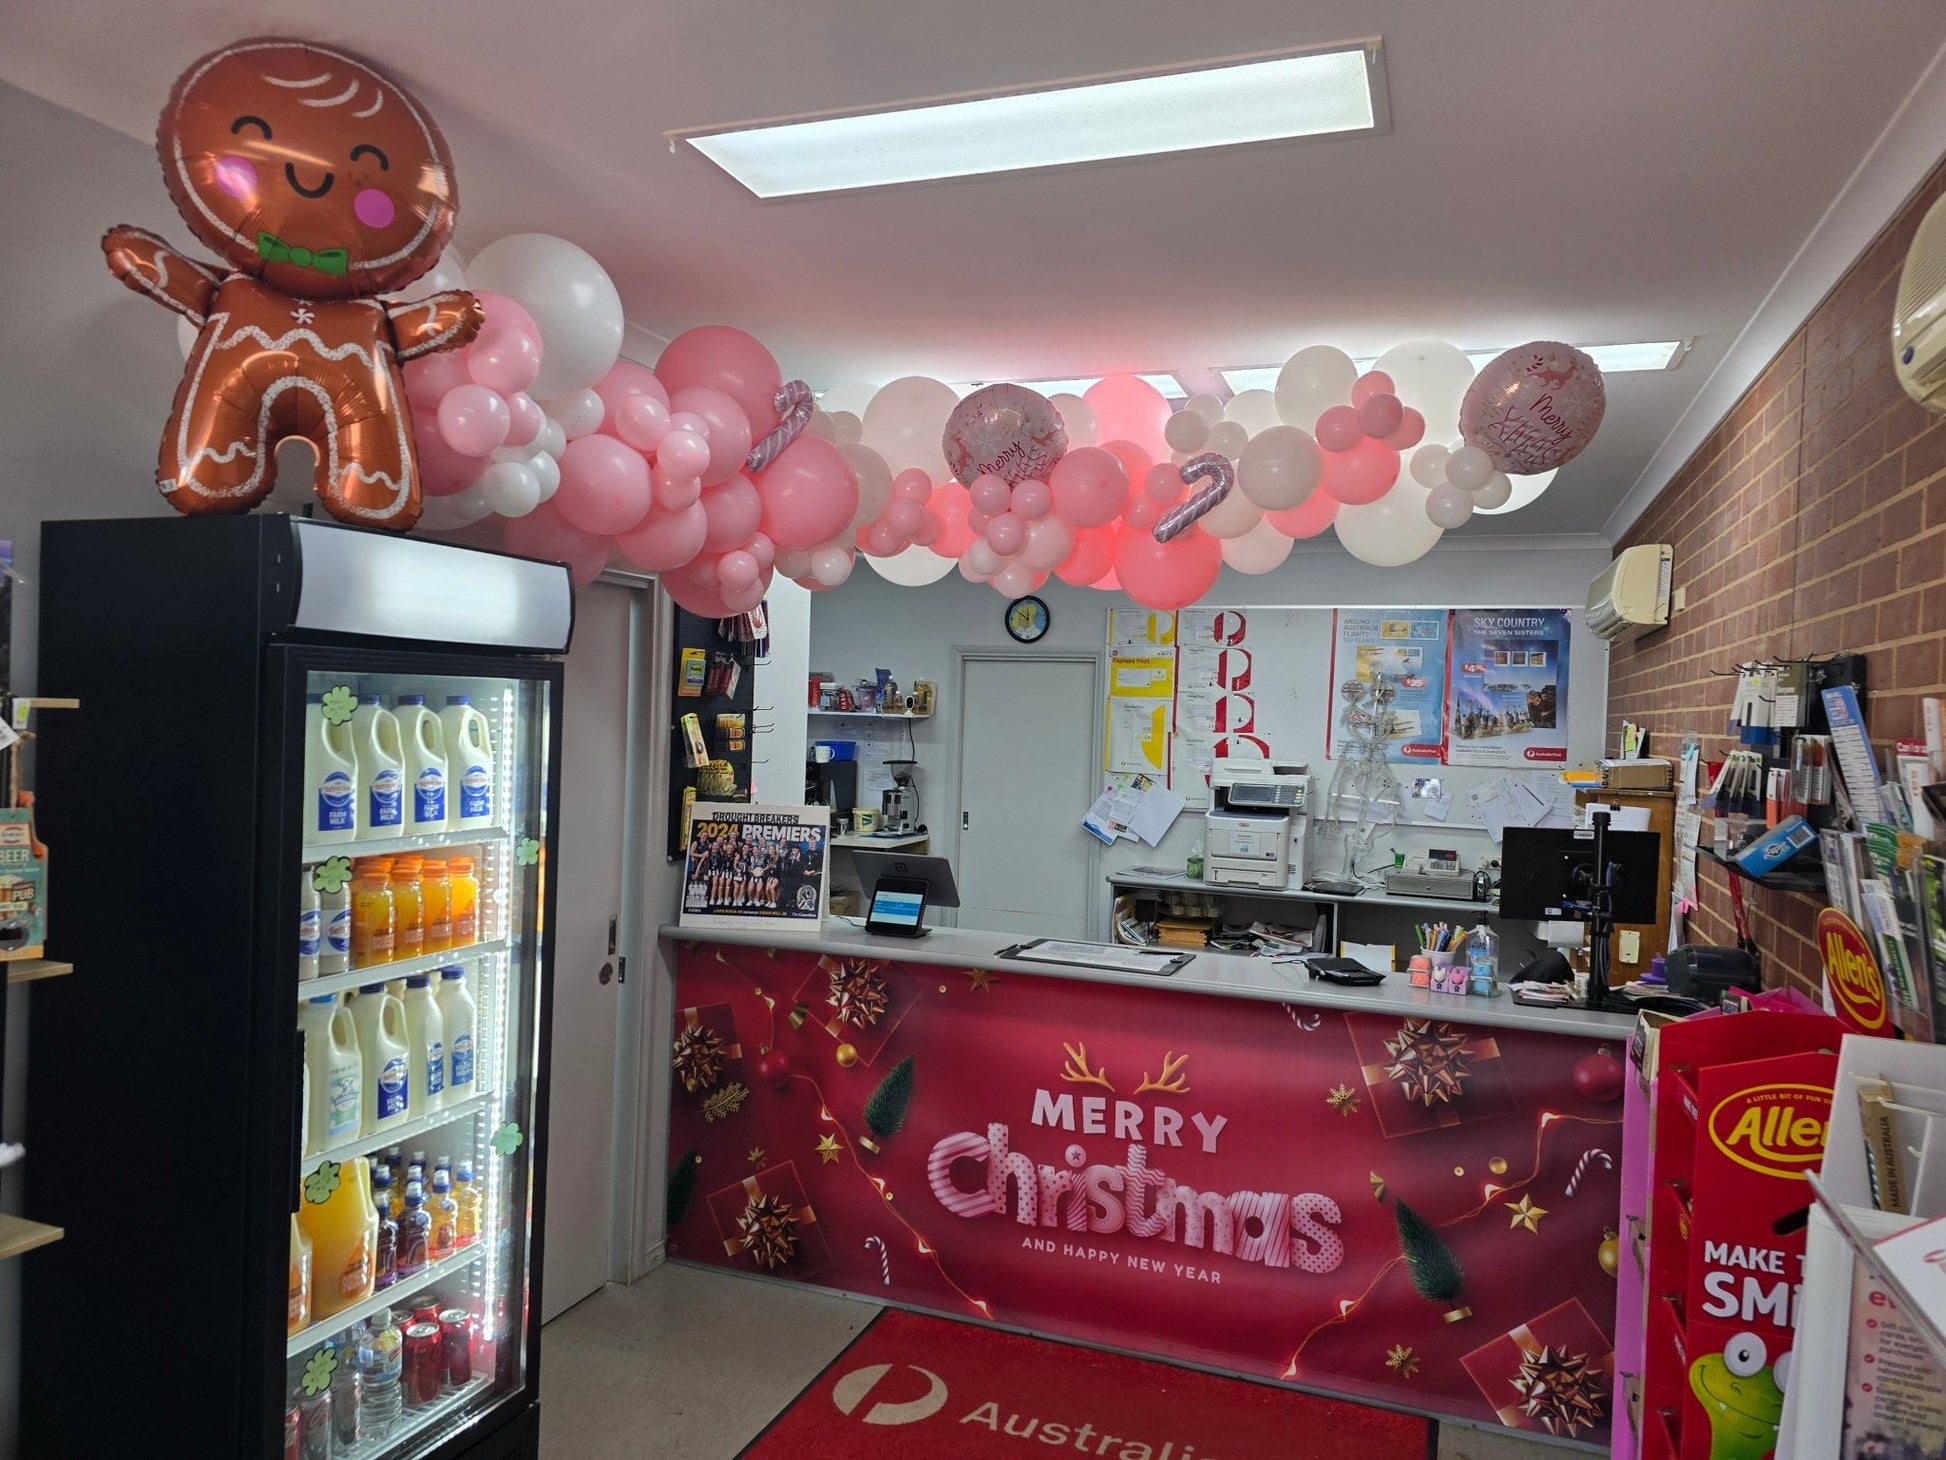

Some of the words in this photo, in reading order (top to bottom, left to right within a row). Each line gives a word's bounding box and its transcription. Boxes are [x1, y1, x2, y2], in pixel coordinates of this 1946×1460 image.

[1530, 393, 1575, 446] Merry
[1474, 617, 1495, 627] SKY
[1497, 617, 1545, 628] COUNTRY
[696, 822, 739, 838] 2024
[742, 824, 822, 842] PREMIERS
[713, 812, 752, 823] DROUGHT
[754, 814, 799, 824] BREAKERS
[12, 888, 35, 900] PUB
[1826, 931, 1881, 1002] Allen's
[1753, 1093, 1777, 1102] LITTLE
[1031, 1088, 1228, 1154] MERRY
[1880, 1116, 1895, 1167] AUSTRALIA
[1887, 1168, 1897, 1178] IN
[928, 1122, 1344, 1274] Christmas
[1888, 1180, 1901, 1208] MADE
[1022, 1237, 1056, 1252] AND
[1063, 1243, 1120, 1265] HAPPY
[1128, 1255, 1166, 1274] NEW
[1174, 1263, 1222, 1285] YEAR
[1704, 1240, 1786, 1275] MAKE
[959, 1402, 1216, 1460] Australi
